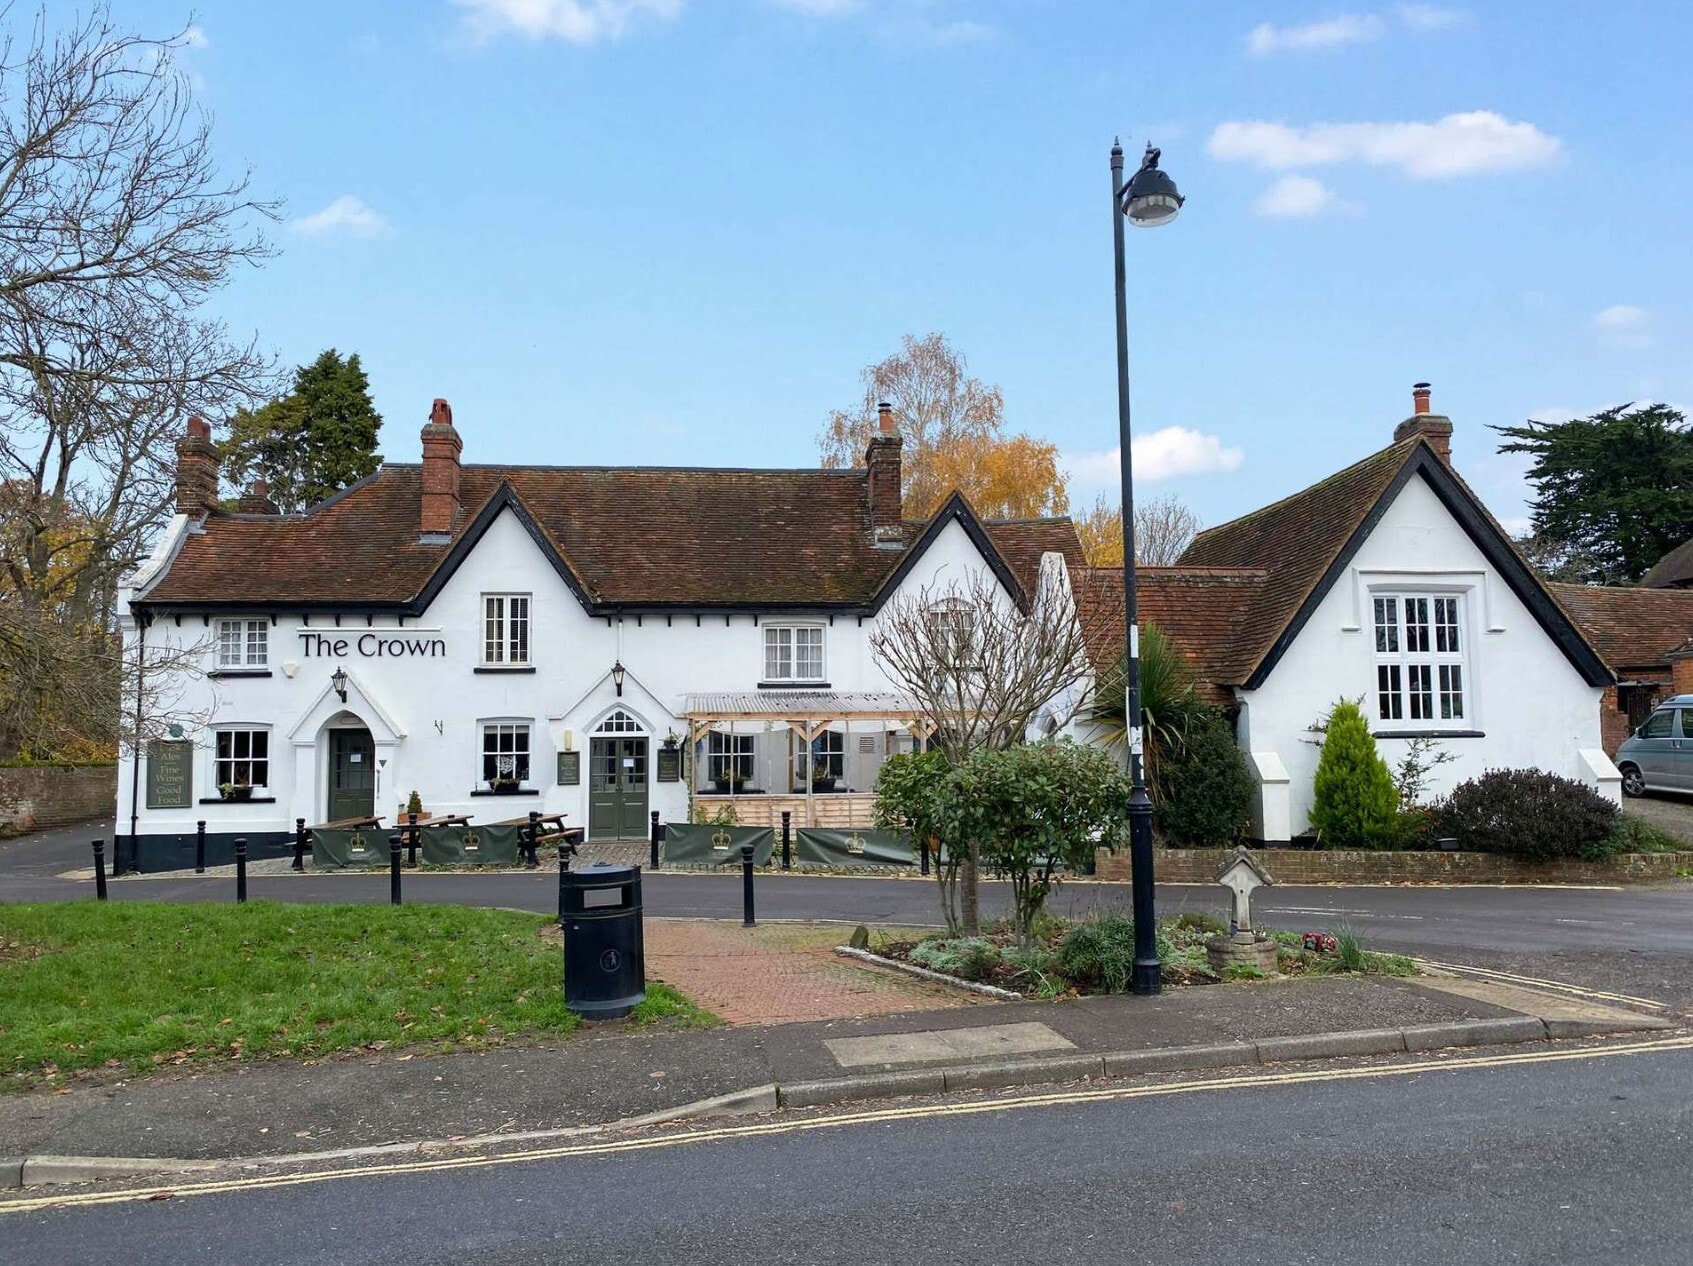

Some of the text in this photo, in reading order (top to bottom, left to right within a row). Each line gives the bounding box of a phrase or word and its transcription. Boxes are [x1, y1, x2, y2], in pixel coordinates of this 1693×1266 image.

[298, 633, 447, 656] The Crown
[160, 765, 180, 774] Fine
[156, 775, 184, 783] Wines
[156, 786, 181, 795] Good
[158, 795, 181, 804] Food
